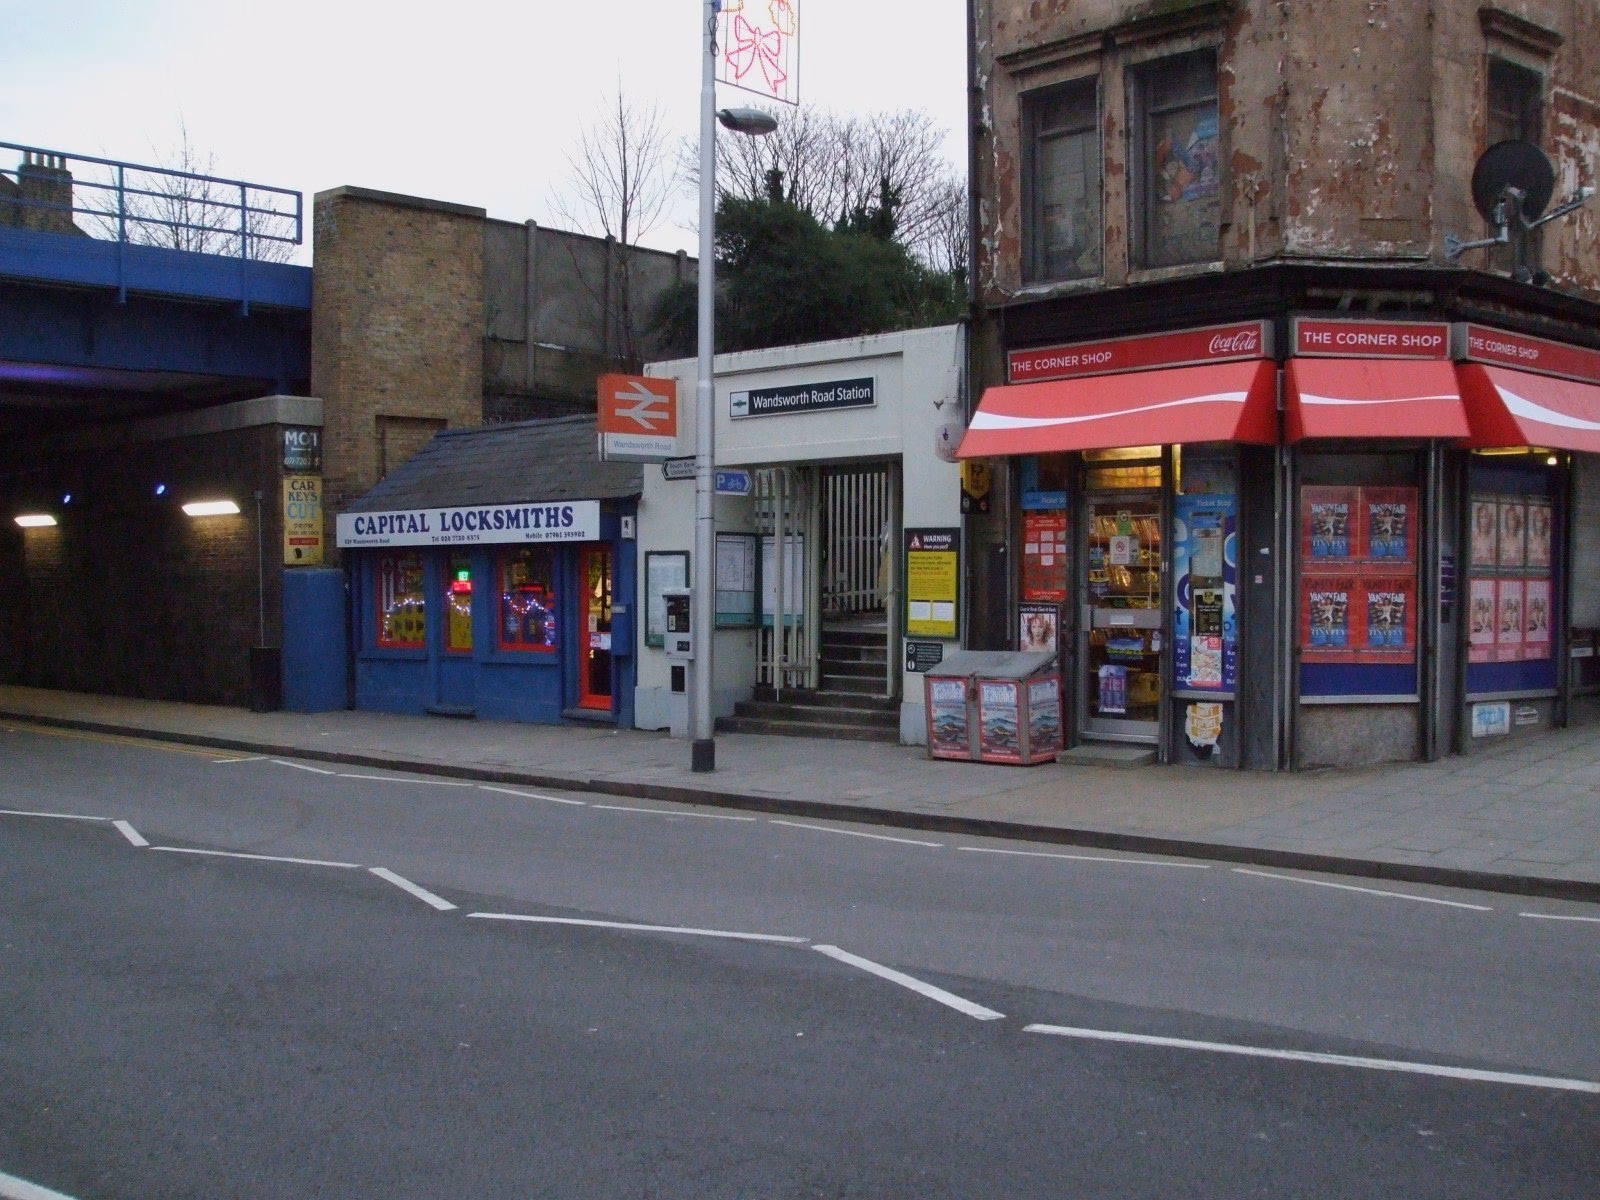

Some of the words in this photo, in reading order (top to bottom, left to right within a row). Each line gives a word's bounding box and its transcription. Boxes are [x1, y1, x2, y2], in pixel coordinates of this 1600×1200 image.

[1304, 332, 1331, 344] THE
[1336, 333, 1397, 346] CORNER
[1402, 335, 1442, 347] SHOP
[1469, 336, 1484, 350] THE
[1486, 340, 1517, 356] CORNER
[1518, 346, 1539, 360] SHOP
[1012, 360, 1032, 372] THE
[1035, 356, 1078, 370] CORNER
[1082, 352, 1112, 364] SHOP
[753, 391, 809, 409] Wandsworth
[812, 389, 834, 403] Road
[837, 386, 871, 401] Station
[613, 440, 653, 450] Wandsworth
[291, 480, 316, 491] CAR
[716, 475, 725, 488] P
[288, 492, 318, 502] KEYS
[287, 502, 318, 518] CUT
[1334, 504, 1348, 514] FAIR
[1392, 504, 1406, 514] FAIR
[354, 513, 430, 535] CAPITAL
[440, 506, 574, 532] LOCKSMITHS
[923, 534, 952, 542] WARNING
[1310, 592, 1334, 602] VANITY
[1334, 592, 1348, 602] FAIR
[1368, 592, 1392, 602] VANITY
[1391, 592, 1405, 602] FAIR
